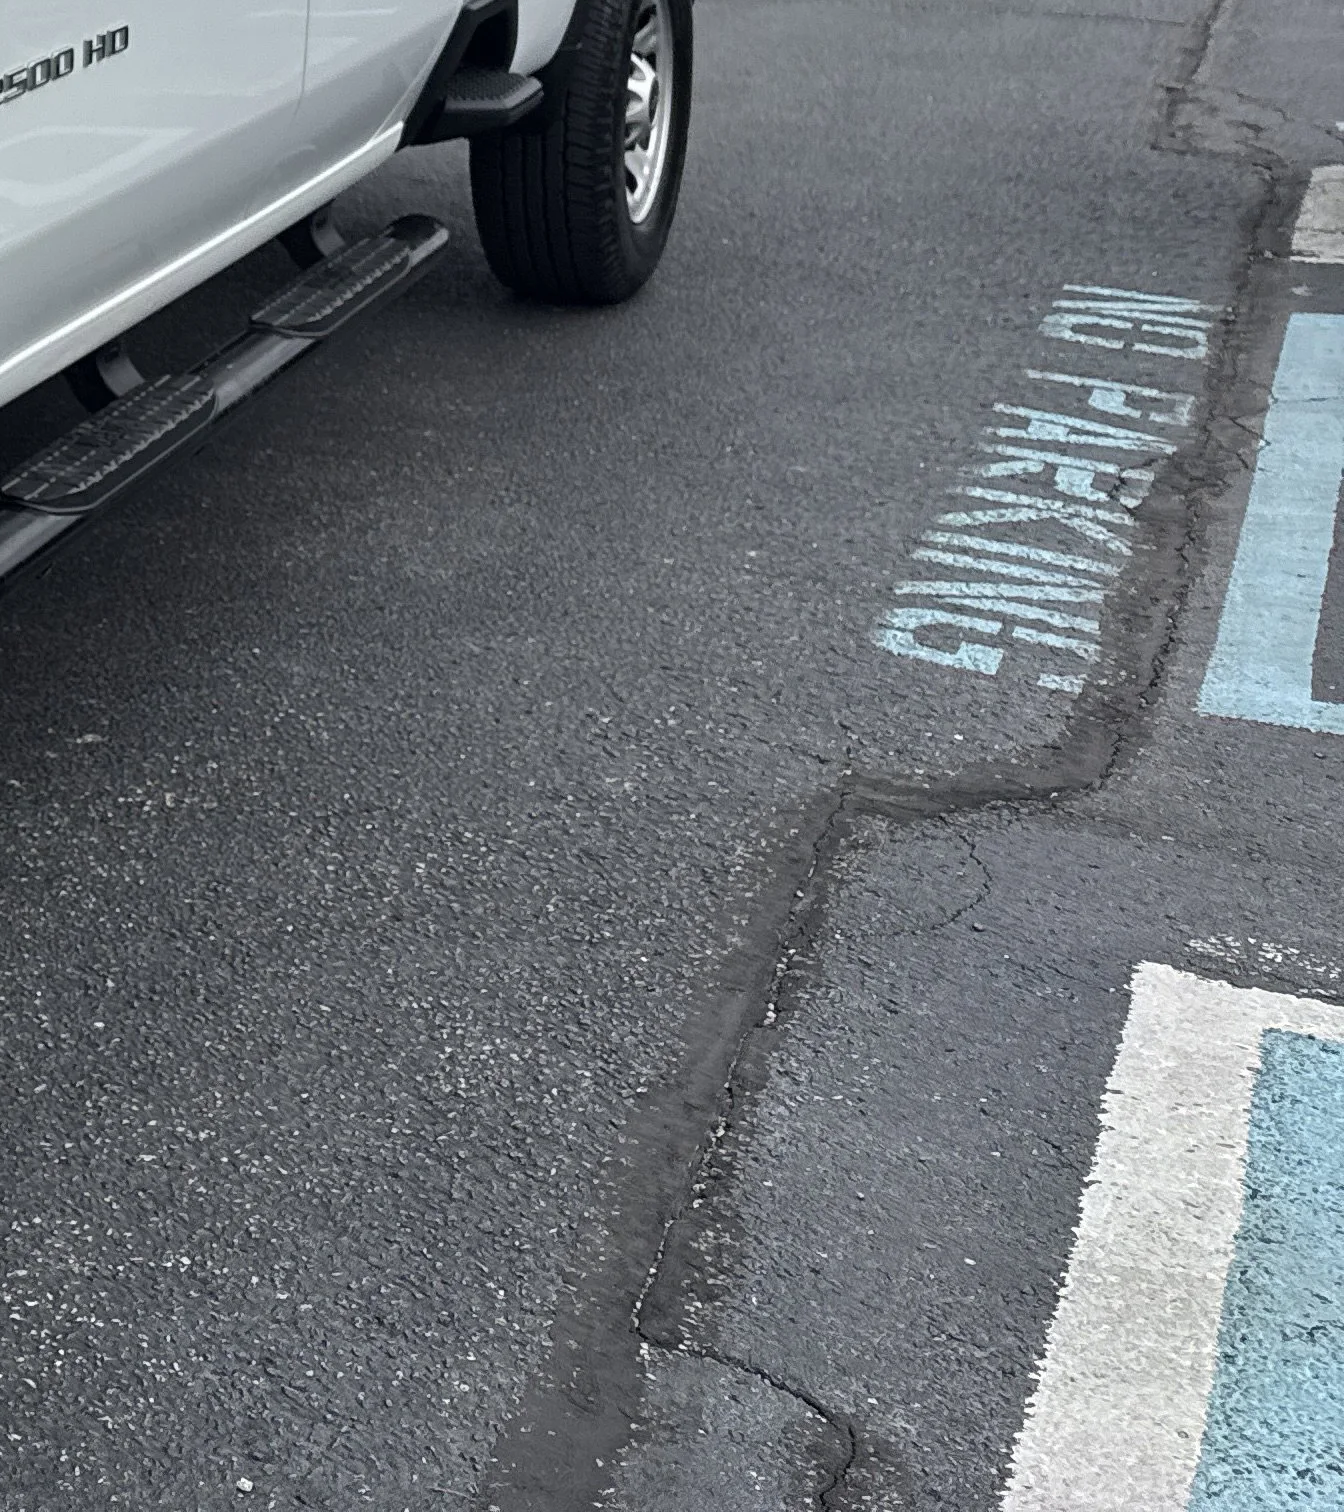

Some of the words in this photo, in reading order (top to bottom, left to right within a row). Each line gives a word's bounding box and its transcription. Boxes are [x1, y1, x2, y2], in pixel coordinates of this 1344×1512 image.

[82, 23, 130, 69] HD
[1039, 283, 1230, 361] NO
[872, 368, 1198, 695] PARKING
